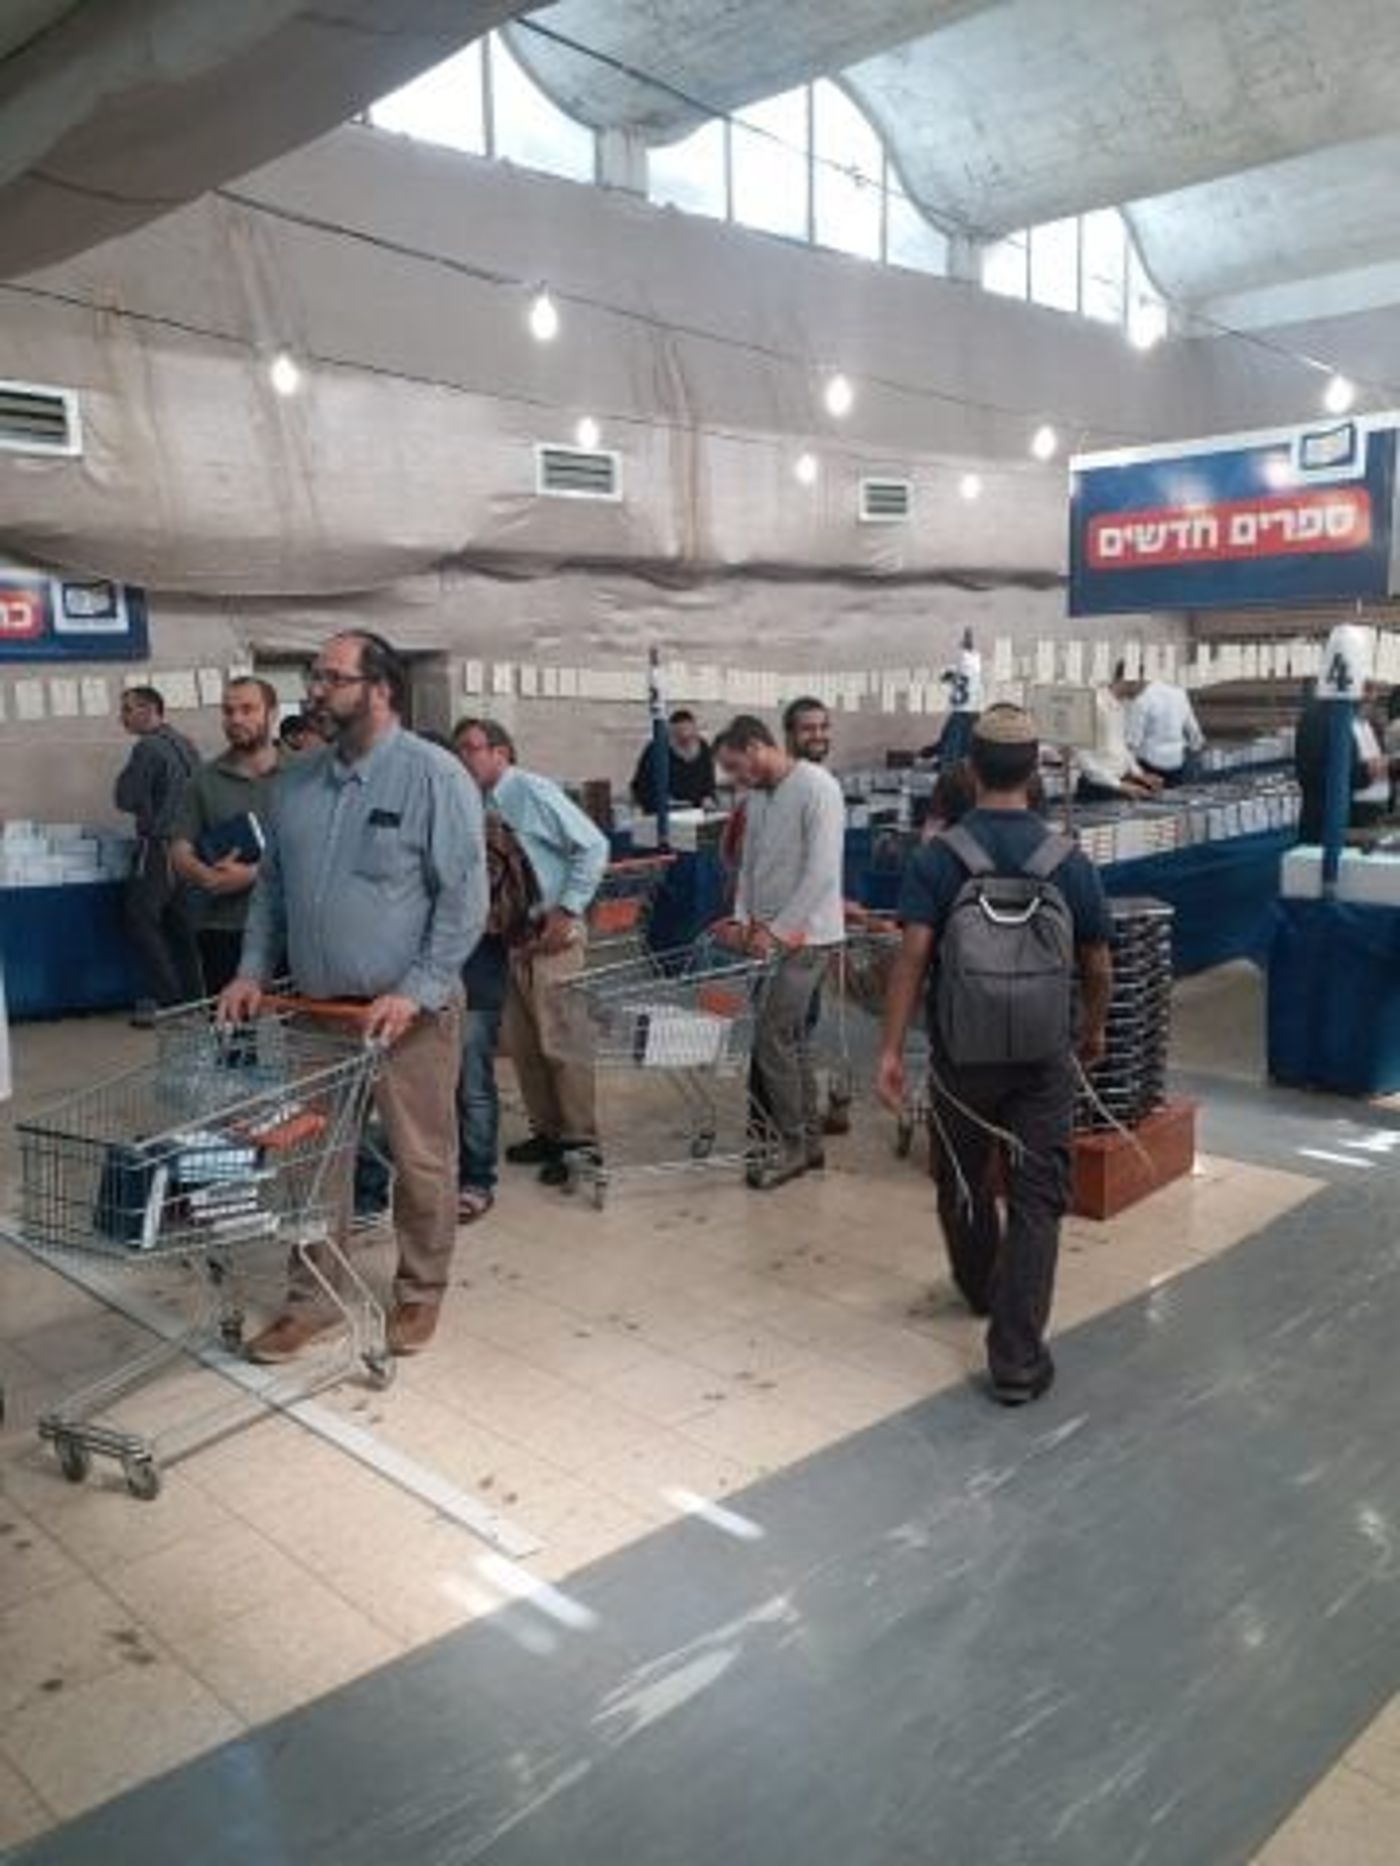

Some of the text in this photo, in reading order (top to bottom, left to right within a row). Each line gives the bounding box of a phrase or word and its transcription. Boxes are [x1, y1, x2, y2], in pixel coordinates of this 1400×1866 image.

[1098, 504, 1356, 558] ספרים חדשים
[1326, 652, 1355, 692] 4
